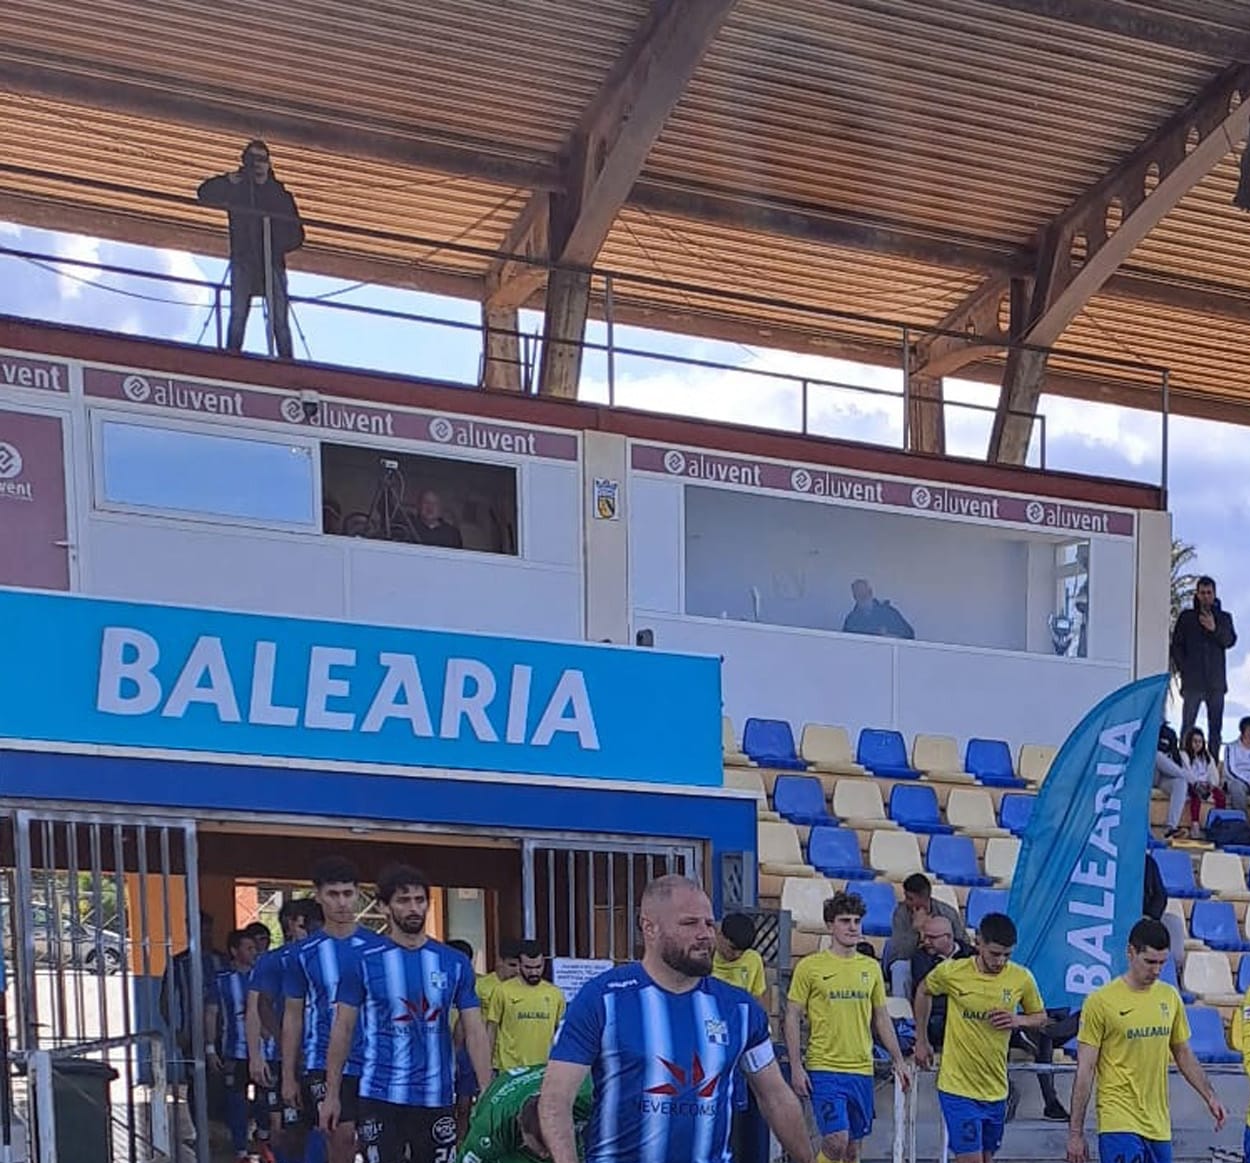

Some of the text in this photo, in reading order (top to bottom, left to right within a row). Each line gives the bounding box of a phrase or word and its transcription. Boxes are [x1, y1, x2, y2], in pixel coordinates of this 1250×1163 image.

[155, 380, 243, 415] aluvent
[309, 402, 394, 436] aluvent
[456, 422, 536, 454] aluvent
[688, 455, 761, 486] aluvent
[814, 471, 883, 502] aluvent
[933, 489, 999, 519] aluvent
[1046, 504, 1108, 532] aluvent
[97, 626, 600, 751] BALEARIA
